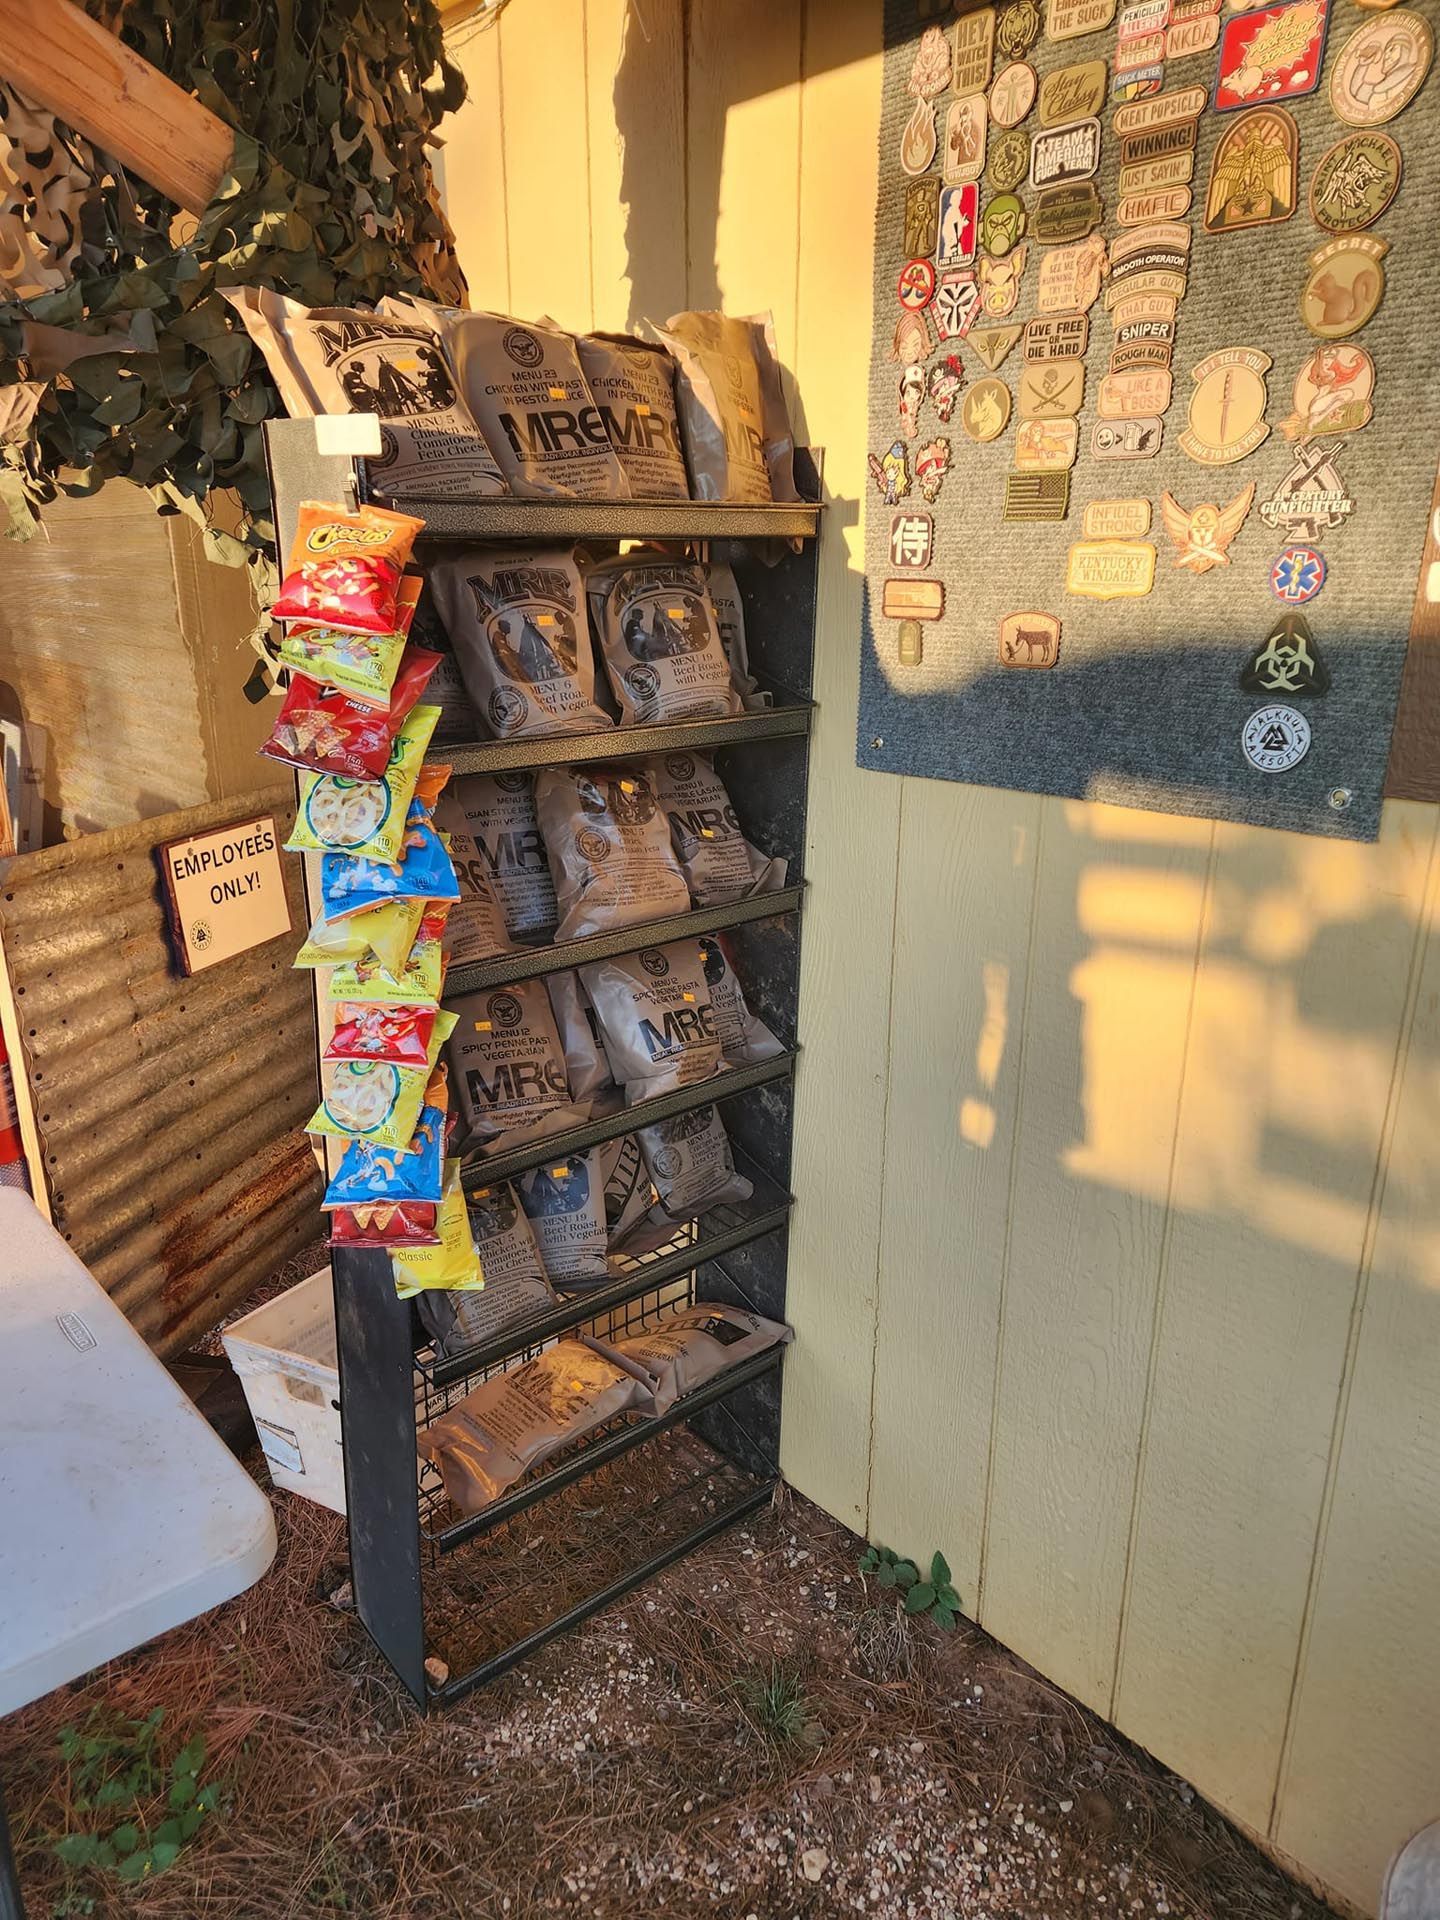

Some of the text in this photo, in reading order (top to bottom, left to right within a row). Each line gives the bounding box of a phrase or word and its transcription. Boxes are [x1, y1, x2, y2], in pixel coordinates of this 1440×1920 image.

[1124, 3, 1165, 22] PENICILLIN
[1174, 1, 1216, 20] ALLERGY
[1053, 7, 1107, 32] THE SUCK
[1122, 14, 1162, 36] ALLERGY
[1274, 13, 1295, 32] THE
[957, 16, 989, 49] HEY,
[1170, 22, 1212, 52] NKDA
[1120, 45, 1161, 67] ALLERGY
[957, 61, 988, 90] THIS!
[1117, 66, 1161, 84] SUCK METER
[1044, 72, 1096, 97] Stay
[1120, 93, 1201, 128] MEAT POPSICLE
[1050, 130, 1085, 150] TEAM
[1127, 127, 1192, 159] WINNING!
[1036, 141, 1095, 168] AMERICA
[1036, 157, 1093, 183] FUCK YEAH!
[1314, 136, 1394, 197] SAINT MICHAEL
[1123, 166, 1147, 188] JUST
[1314, 236, 1383, 266] SECRET
[1112, 254, 1186, 278] SMOOTH OPERATOR
[1111, 276, 1182, 299] REGULAR GUY
[1120, 300, 1170, 319] THAT GUY
[1029, 320, 1084, 337] LIVE FREE
[1121, 323, 1169, 341] SNIPER
[1049, 335, 1060, 345] OR
[1027, 342, 1080, 359] DIE HARD
[1114, 348, 1167, 365] ROUGH MAN
[1219, 351, 1241, 365] TELL
[1244, 352, 1264, 370] YOU
[511, 369, 558, 382] MENU 23
[622, 367, 660, 386] MENU 23
[485, 380, 556, 395] CHICKEN WITH
[592, 378, 634, 391] CHICKEN
[1127, 377, 1165, 394] LIKE A
[503, 394, 550, 406] IN PESTO
[607, 389, 650, 404] IN PESTO
[1132, 395, 1163, 410] BOSS
[406, 415, 455, 430] MENU 5
[498, 406, 608, 453] MRE
[410, 424, 460, 441] Chicken
[414, 434, 475, 451] Tomatoes
[417, 446, 446, 461] Feta
[1292, 489, 1345, 502] CENTURY
[1092, 505, 1143, 520] INFIDEL
[1261, 498, 1351, 514] GUNFIGHTER
[1091, 519, 1143, 533] STRONG
[307, 523, 395, 553] Cheetos
[892, 517, 929, 565] 侍
[1078, 556, 1144, 569] KENTUCKY
[1082, 569, 1137, 582] WINDAGE
[466, 567, 577, 624] MRE
[369, 661, 383, 671] 170
[670, 653, 714, 668] MENU 19
[673, 661, 724, 677] Beef Roast
[564, 679, 572, 689] 6
[675, 675, 697, 685] with
[345, 699, 373, 714] CHEESE
[1251, 710, 1305, 735] VALKNUT
[1247, 744, 1301, 766] AIRSOFT
[674, 781, 698, 792] MENU
[496, 797, 521, 805] MENU
[490, 807, 516, 816] STYLE
[480, 819, 502, 828] WITH
[377, 836, 390, 847] 110
[174, 832, 274, 880] EMPLOYEES
[473, 831, 549, 870] MR
[210, 871, 261, 904] ONLY!
[651, 977, 679, 989] MENU 12
[632, 981, 701, 1003] SPICY PENNE PASTA
[491, 1028, 530, 1040] MENU 12
[638, 1003, 719, 1055] MRE
[462, 1042, 493, 1055] SPICY
[494, 1039, 528, 1050] PENNE
[483, 1047, 546, 1062] VEGETARIAN
[465, 1058, 568, 1106] MRE
[543, 1212, 588, 1227] MENU 19
[544, 1219, 598, 1236] Beef Roast
[507, 1233, 515, 1241] 5
[544, 1226, 608, 1244] with Vegetab
[398, 1251, 433, 1263] Classic
[480, 1243, 518, 1261] Chicken
[482, 1248, 528, 1269] Tomatoes
[483, 1266, 504, 1278] Feta
